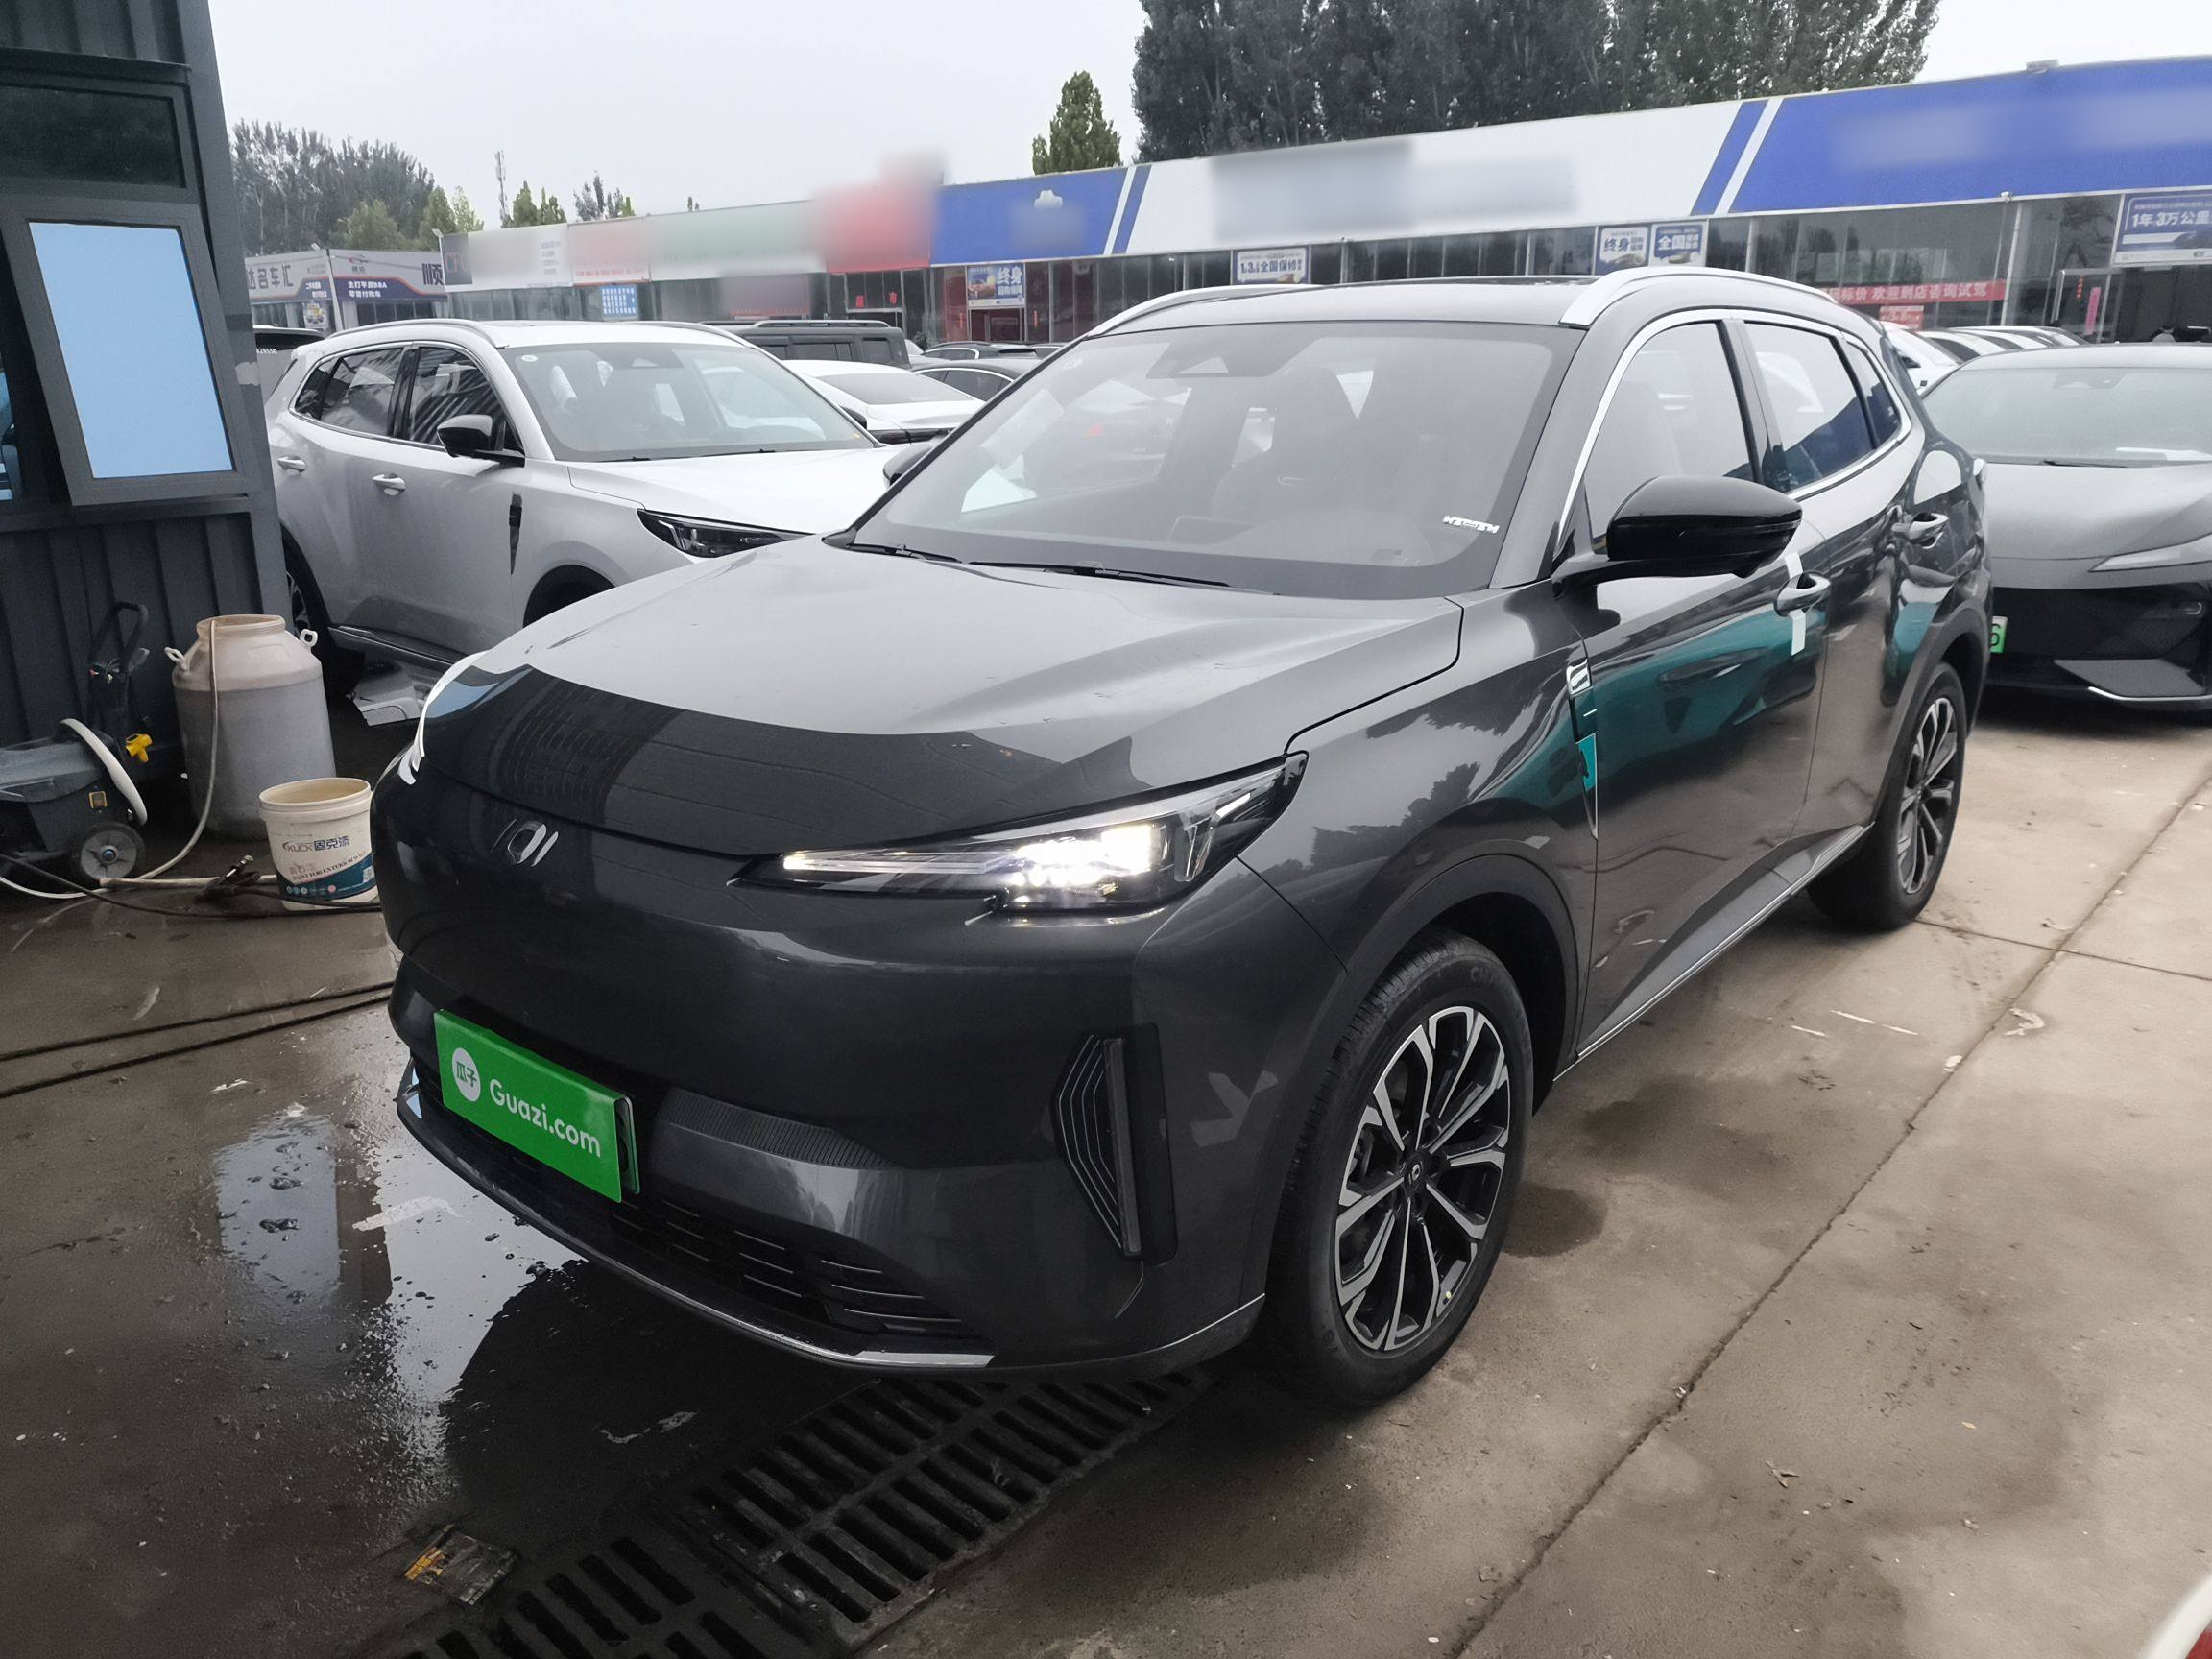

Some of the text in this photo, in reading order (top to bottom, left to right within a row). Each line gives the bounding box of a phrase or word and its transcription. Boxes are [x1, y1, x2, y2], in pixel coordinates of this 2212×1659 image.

[998, 266, 1022, 284] 终身
[456, 1061, 477, 1088] 瓜子
[489, 1078, 601, 1159] Guazi.com
